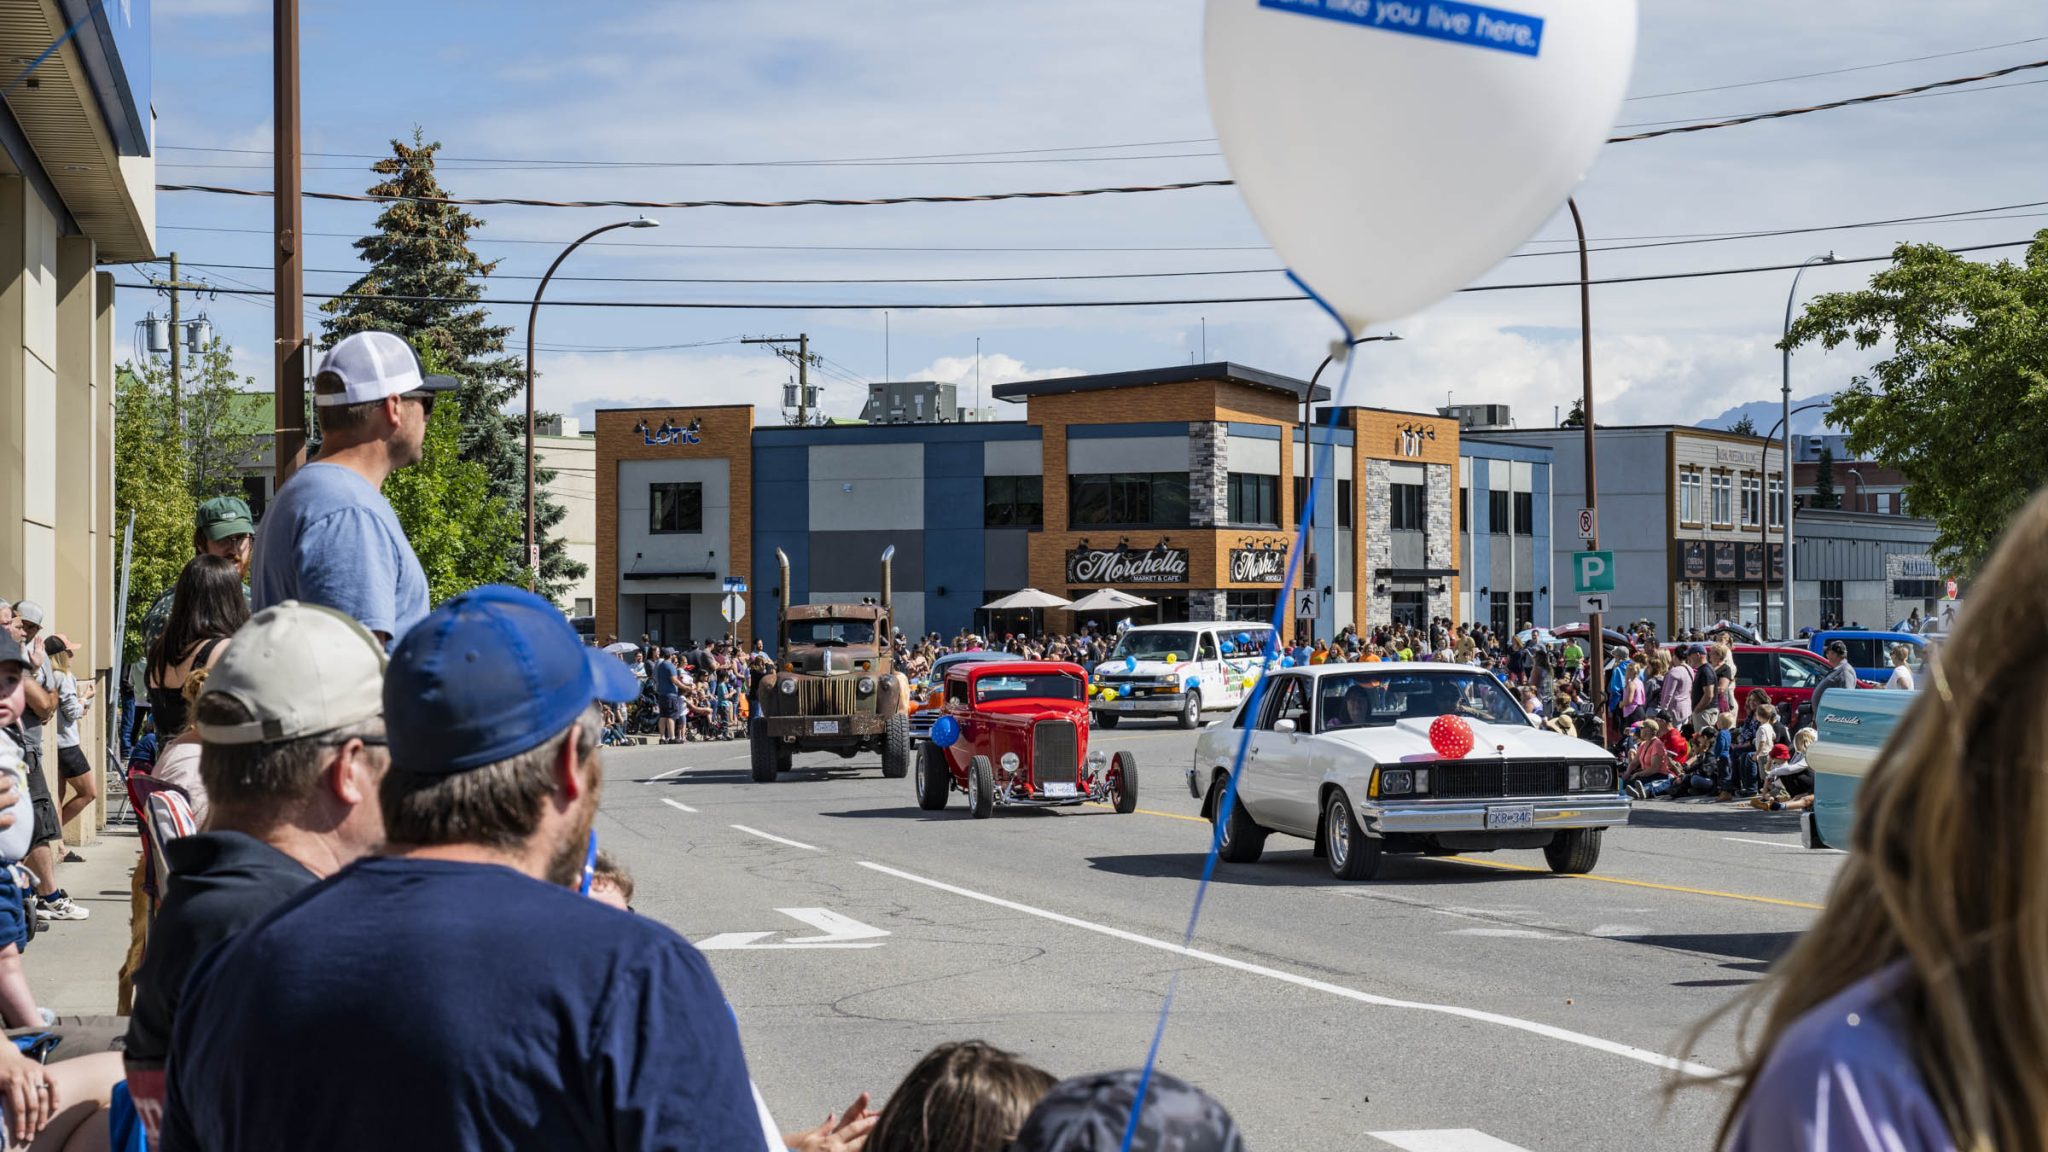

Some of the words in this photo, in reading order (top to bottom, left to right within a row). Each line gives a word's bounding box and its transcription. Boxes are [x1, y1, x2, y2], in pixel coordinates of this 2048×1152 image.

[1374, 1, 1421, 26] you
[1426, 5, 1471, 35] live
[1475, 13, 1536, 47] here.
[644, 427, 701, 446] LOTIC
[1077, 550, 1186, 582] Morchella
[1234, 551, 1280, 581] Market
[1581, 556, 1605, 588] P
